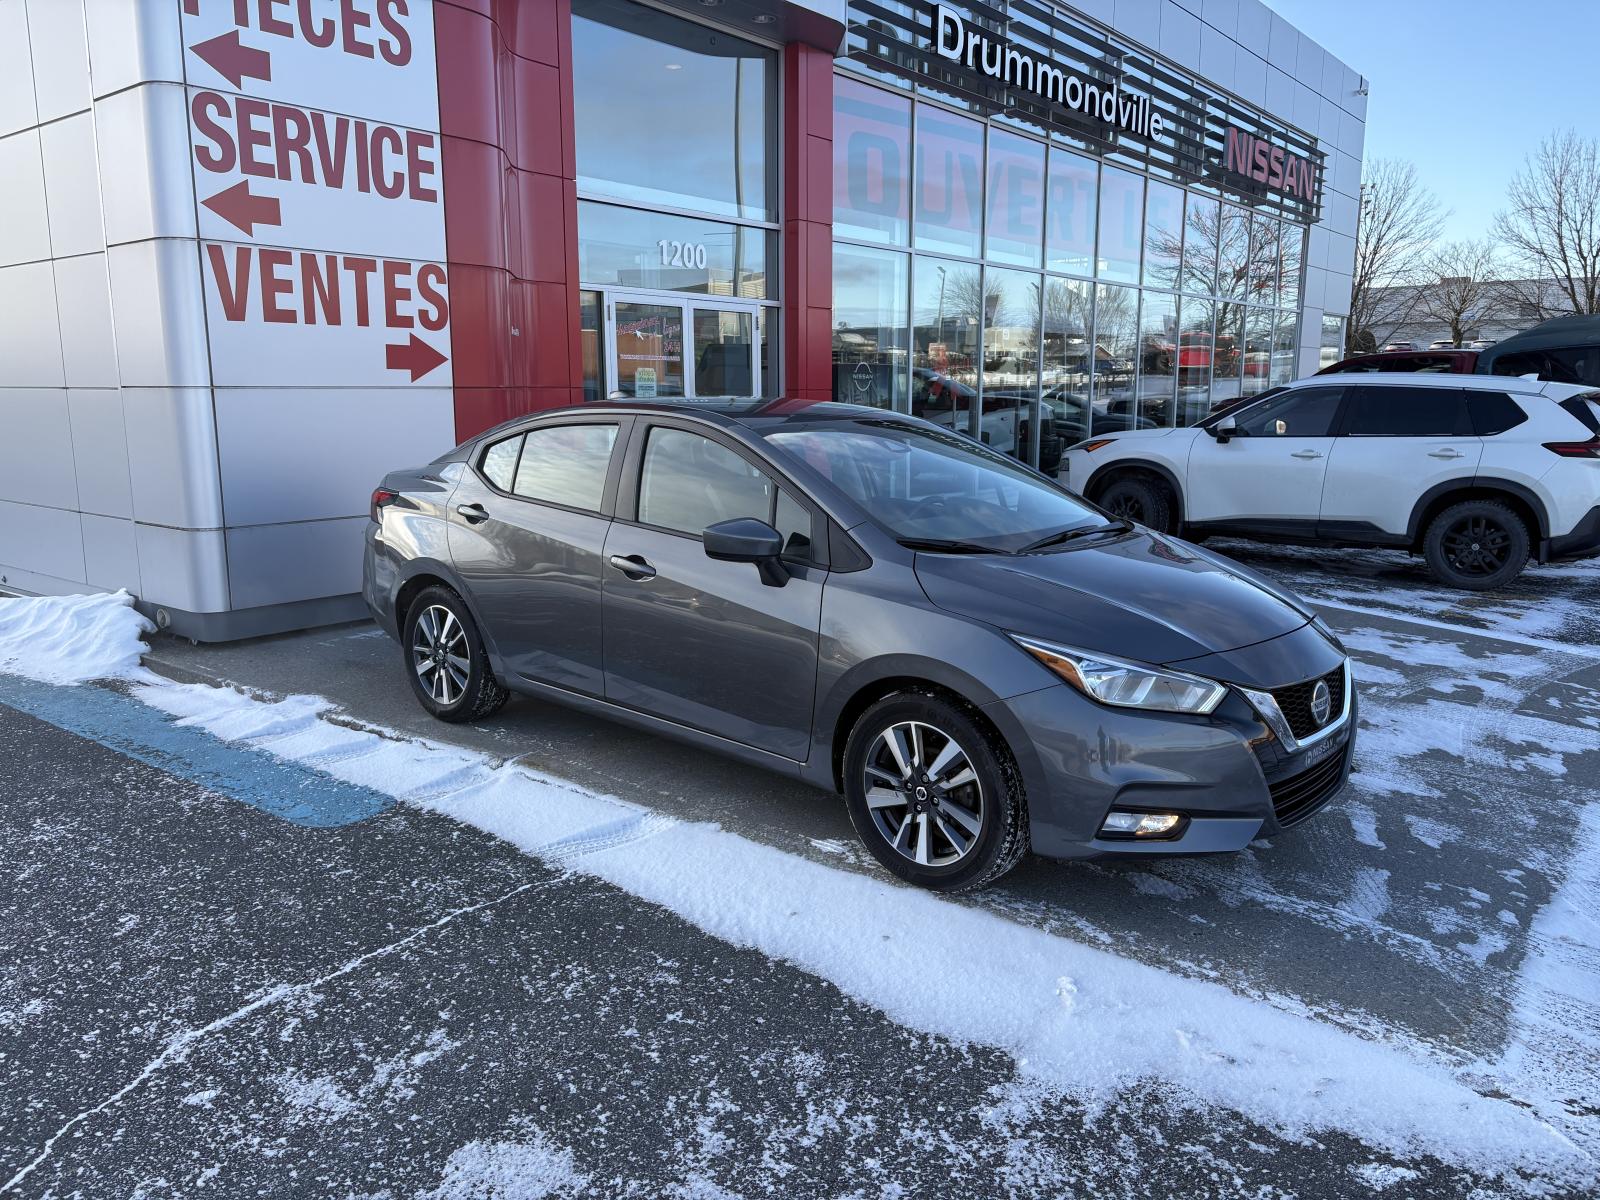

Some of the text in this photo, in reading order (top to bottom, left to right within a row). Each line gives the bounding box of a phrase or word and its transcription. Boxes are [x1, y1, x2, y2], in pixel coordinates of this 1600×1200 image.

[183, 0, 412, 66] CES
[935, 4, 1164, 142] Drummondville
[191, 91, 438, 203] SERVICE
[848, 130, 1107, 249] OUVERT
[1226, 127, 1316, 200] NISSAN
[206, 244, 449, 331] VENTES
[658, 239, 707, 270] 1200
